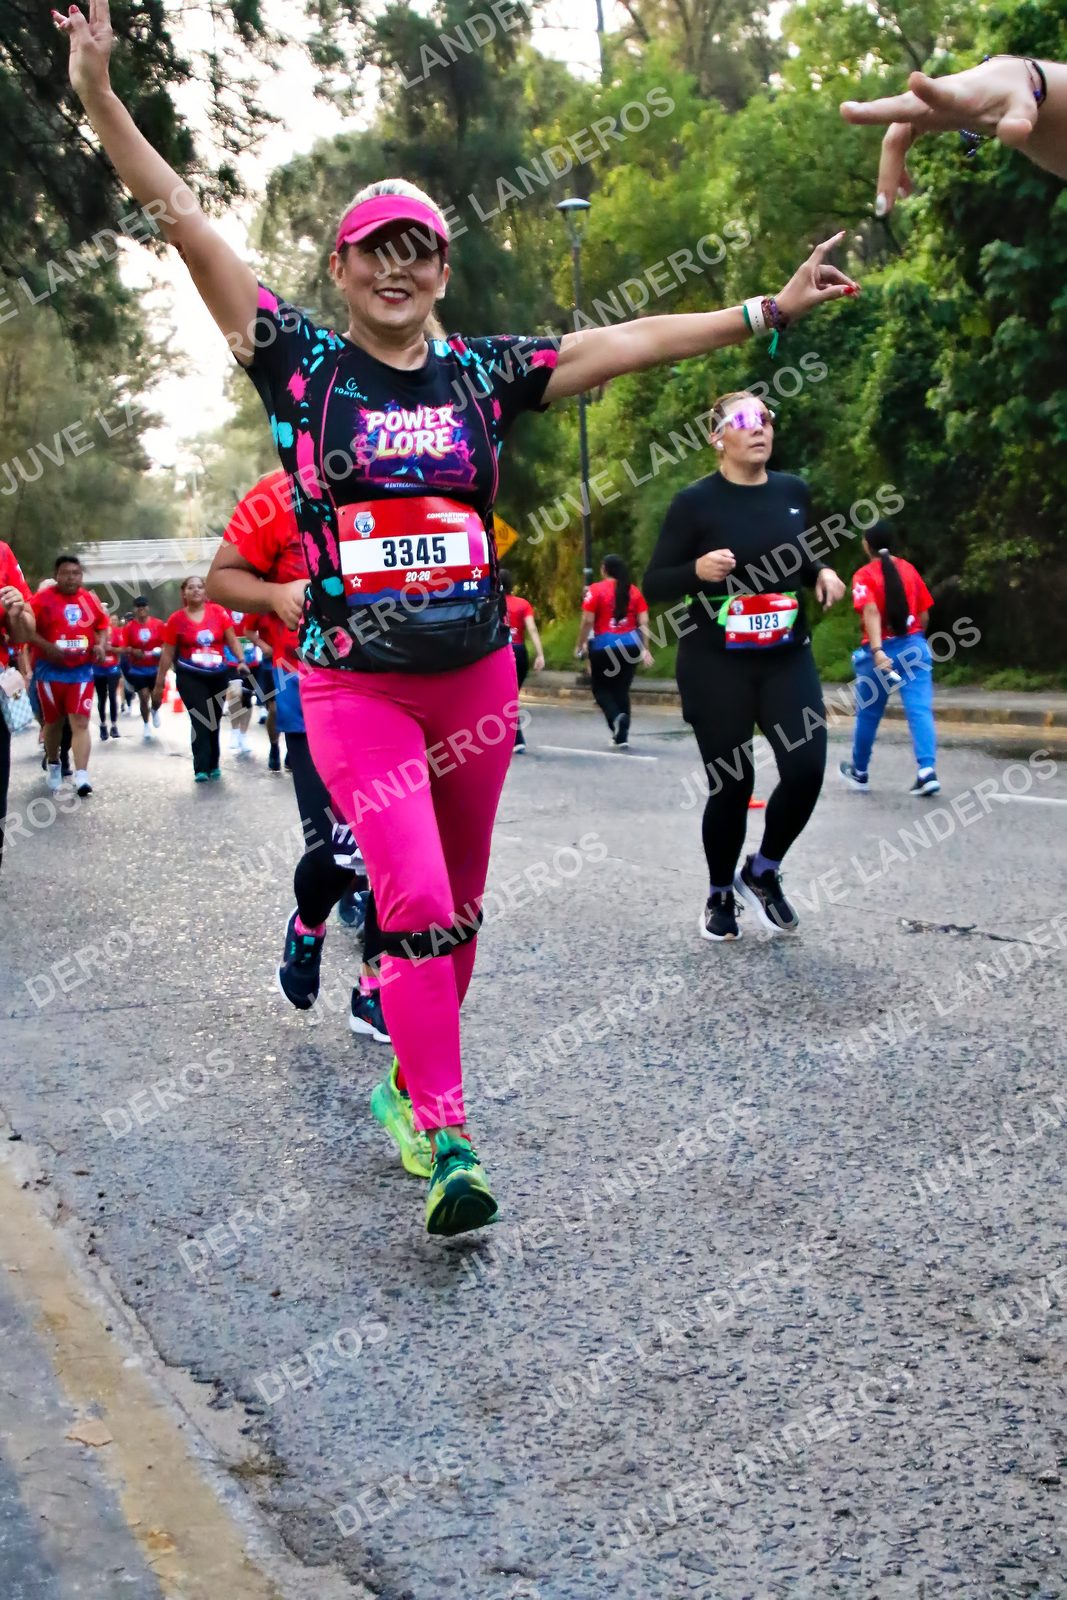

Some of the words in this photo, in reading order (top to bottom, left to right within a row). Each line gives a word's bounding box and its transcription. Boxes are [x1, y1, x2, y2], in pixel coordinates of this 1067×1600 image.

[366, 405, 461, 432] POWER
[376, 427, 455, 458] LORE
[382, 536, 447, 568] 3345
[463, 581, 479, 591] 5K
[749, 613, 778, 630] 1923
